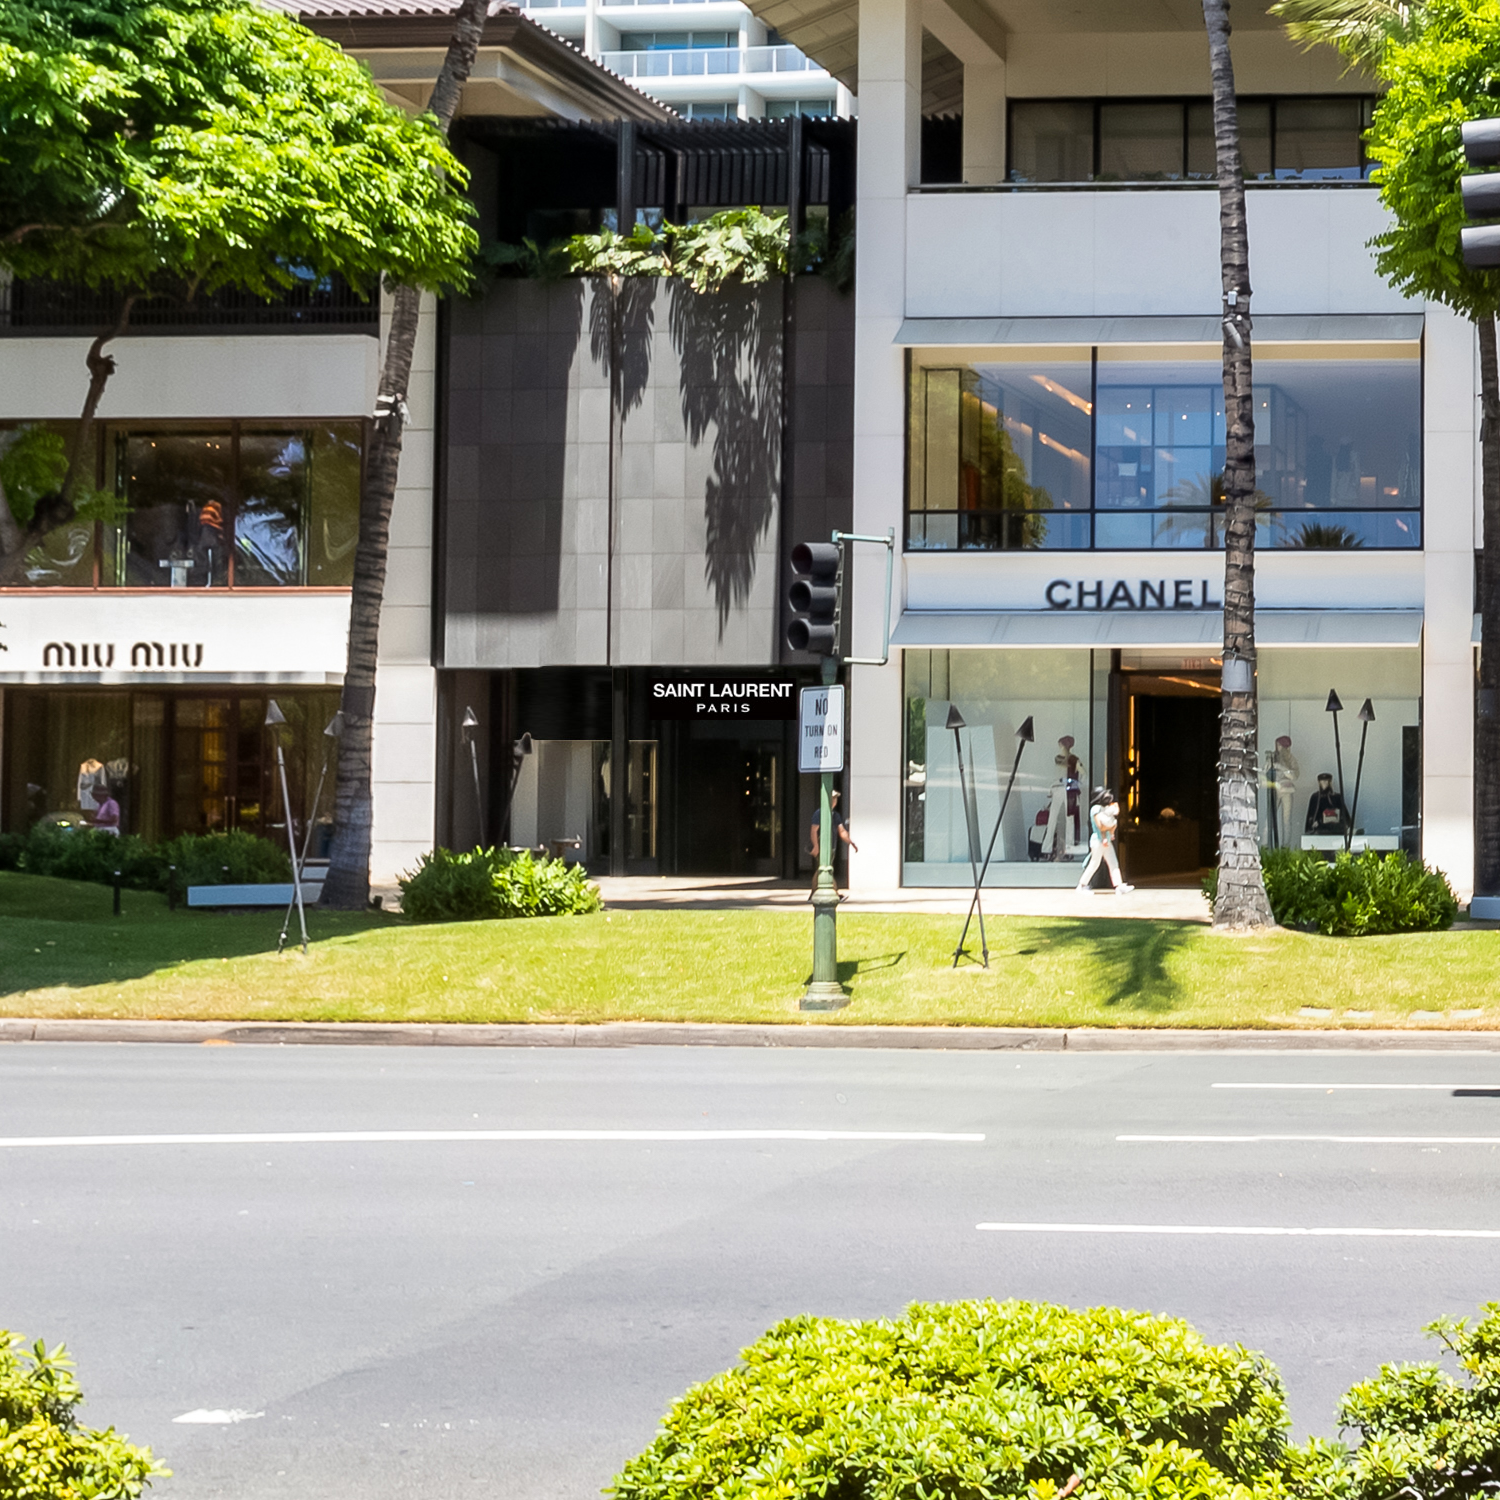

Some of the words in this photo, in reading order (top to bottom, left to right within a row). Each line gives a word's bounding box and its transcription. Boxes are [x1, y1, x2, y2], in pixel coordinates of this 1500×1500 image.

[1045, 579, 1222, 610] CHANEL
[653, 683, 706, 698] SAINT
[709, 683, 793, 698] LAURENT
[696, 703, 751, 713] PARIS
[815, 698, 828, 716] NO
[805, 725, 824, 737] TURN
[828, 725, 838, 736] ON
[814, 746, 829, 758] RED
